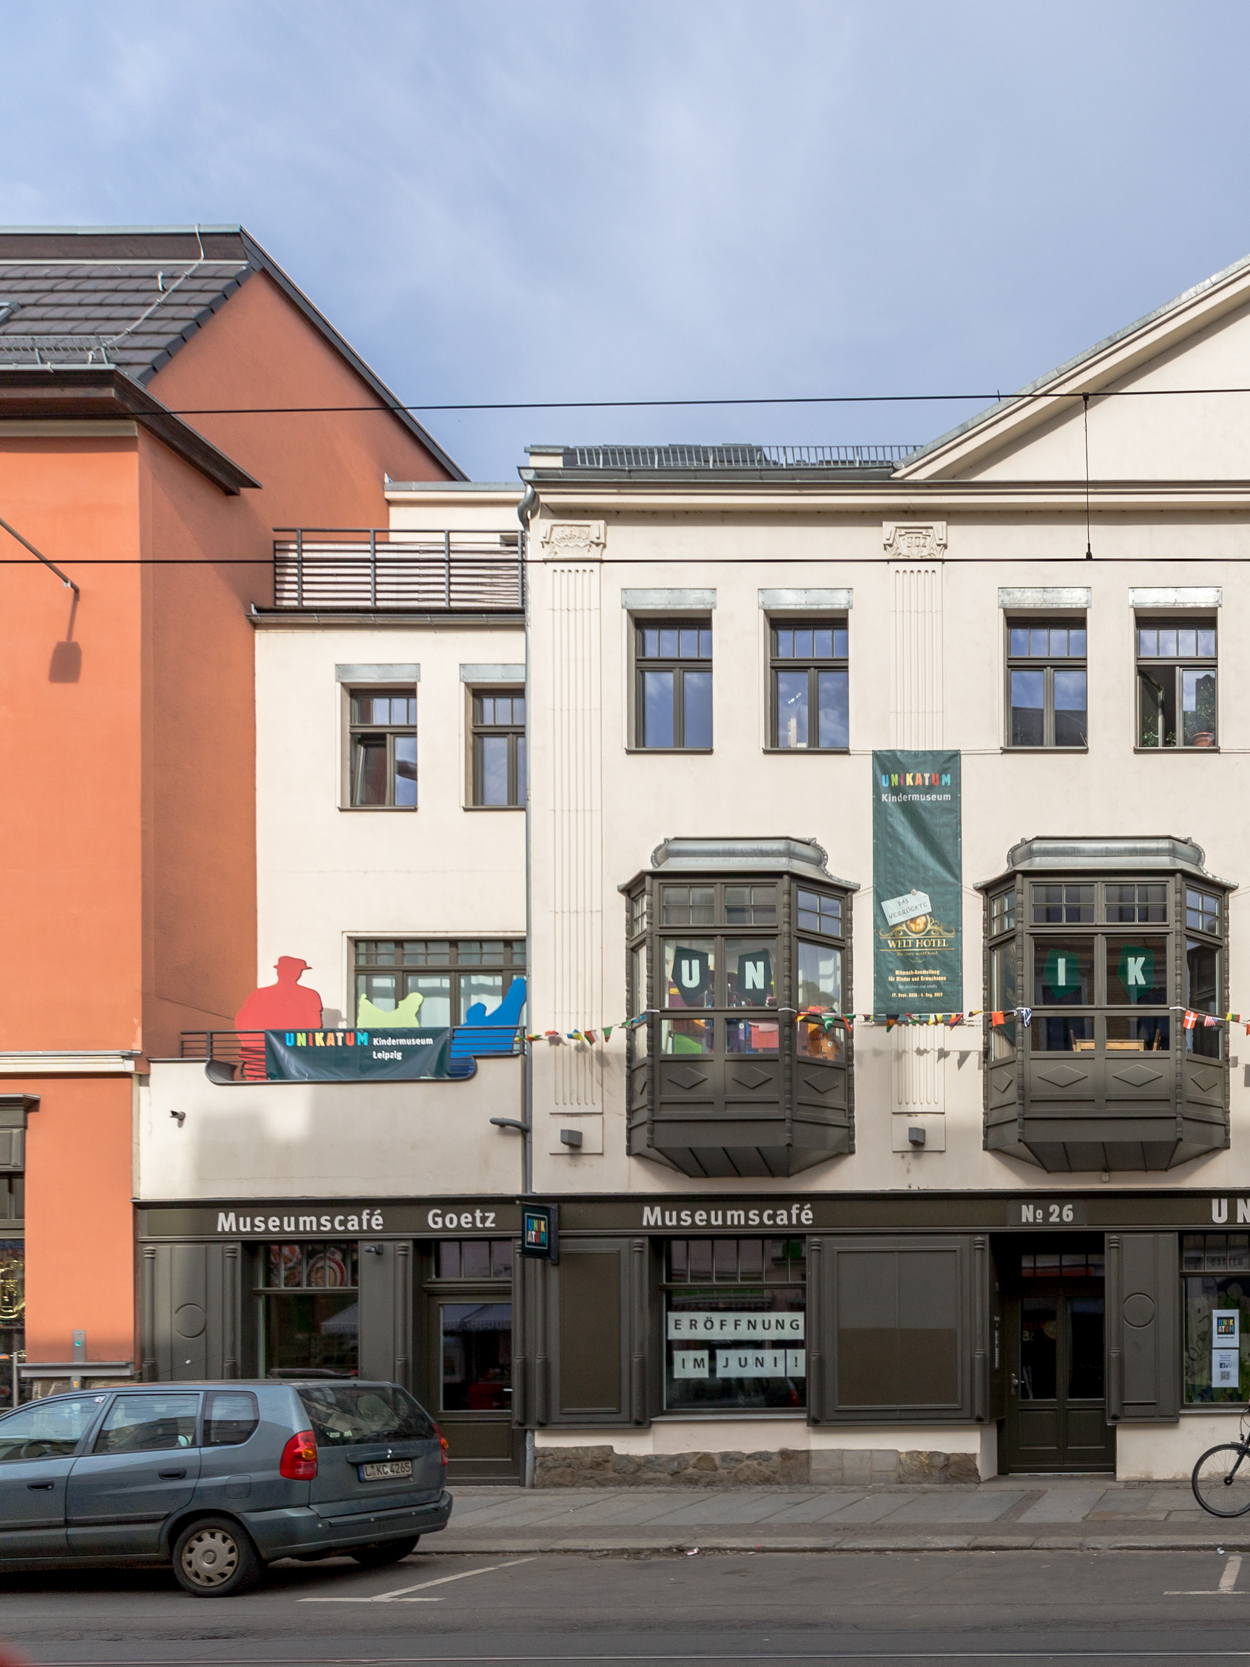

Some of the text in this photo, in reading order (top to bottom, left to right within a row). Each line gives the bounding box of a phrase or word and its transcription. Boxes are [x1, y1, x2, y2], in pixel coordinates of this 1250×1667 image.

[882, 773, 951, 787] UNIKATUM
[882, 793, 951, 802] Kindermuseum
[889, 902, 928, 920] VERRÜCKTE
[888, 939, 948, 948] WELT HOTEL
[285, 1032, 433, 1046] UNIKATUM Kindermuseum
[373, 1050, 402, 1060] Leipzig
[217, 1208, 496, 1232] Museumscafé Goetz
[642, 1204, 813, 1226] Museumscafé
[1049, 1204, 1073, 1222] 26
[674, 1317, 800, 1330] ERÖFFNUNG
[682, 1358, 705, 1369] IM
